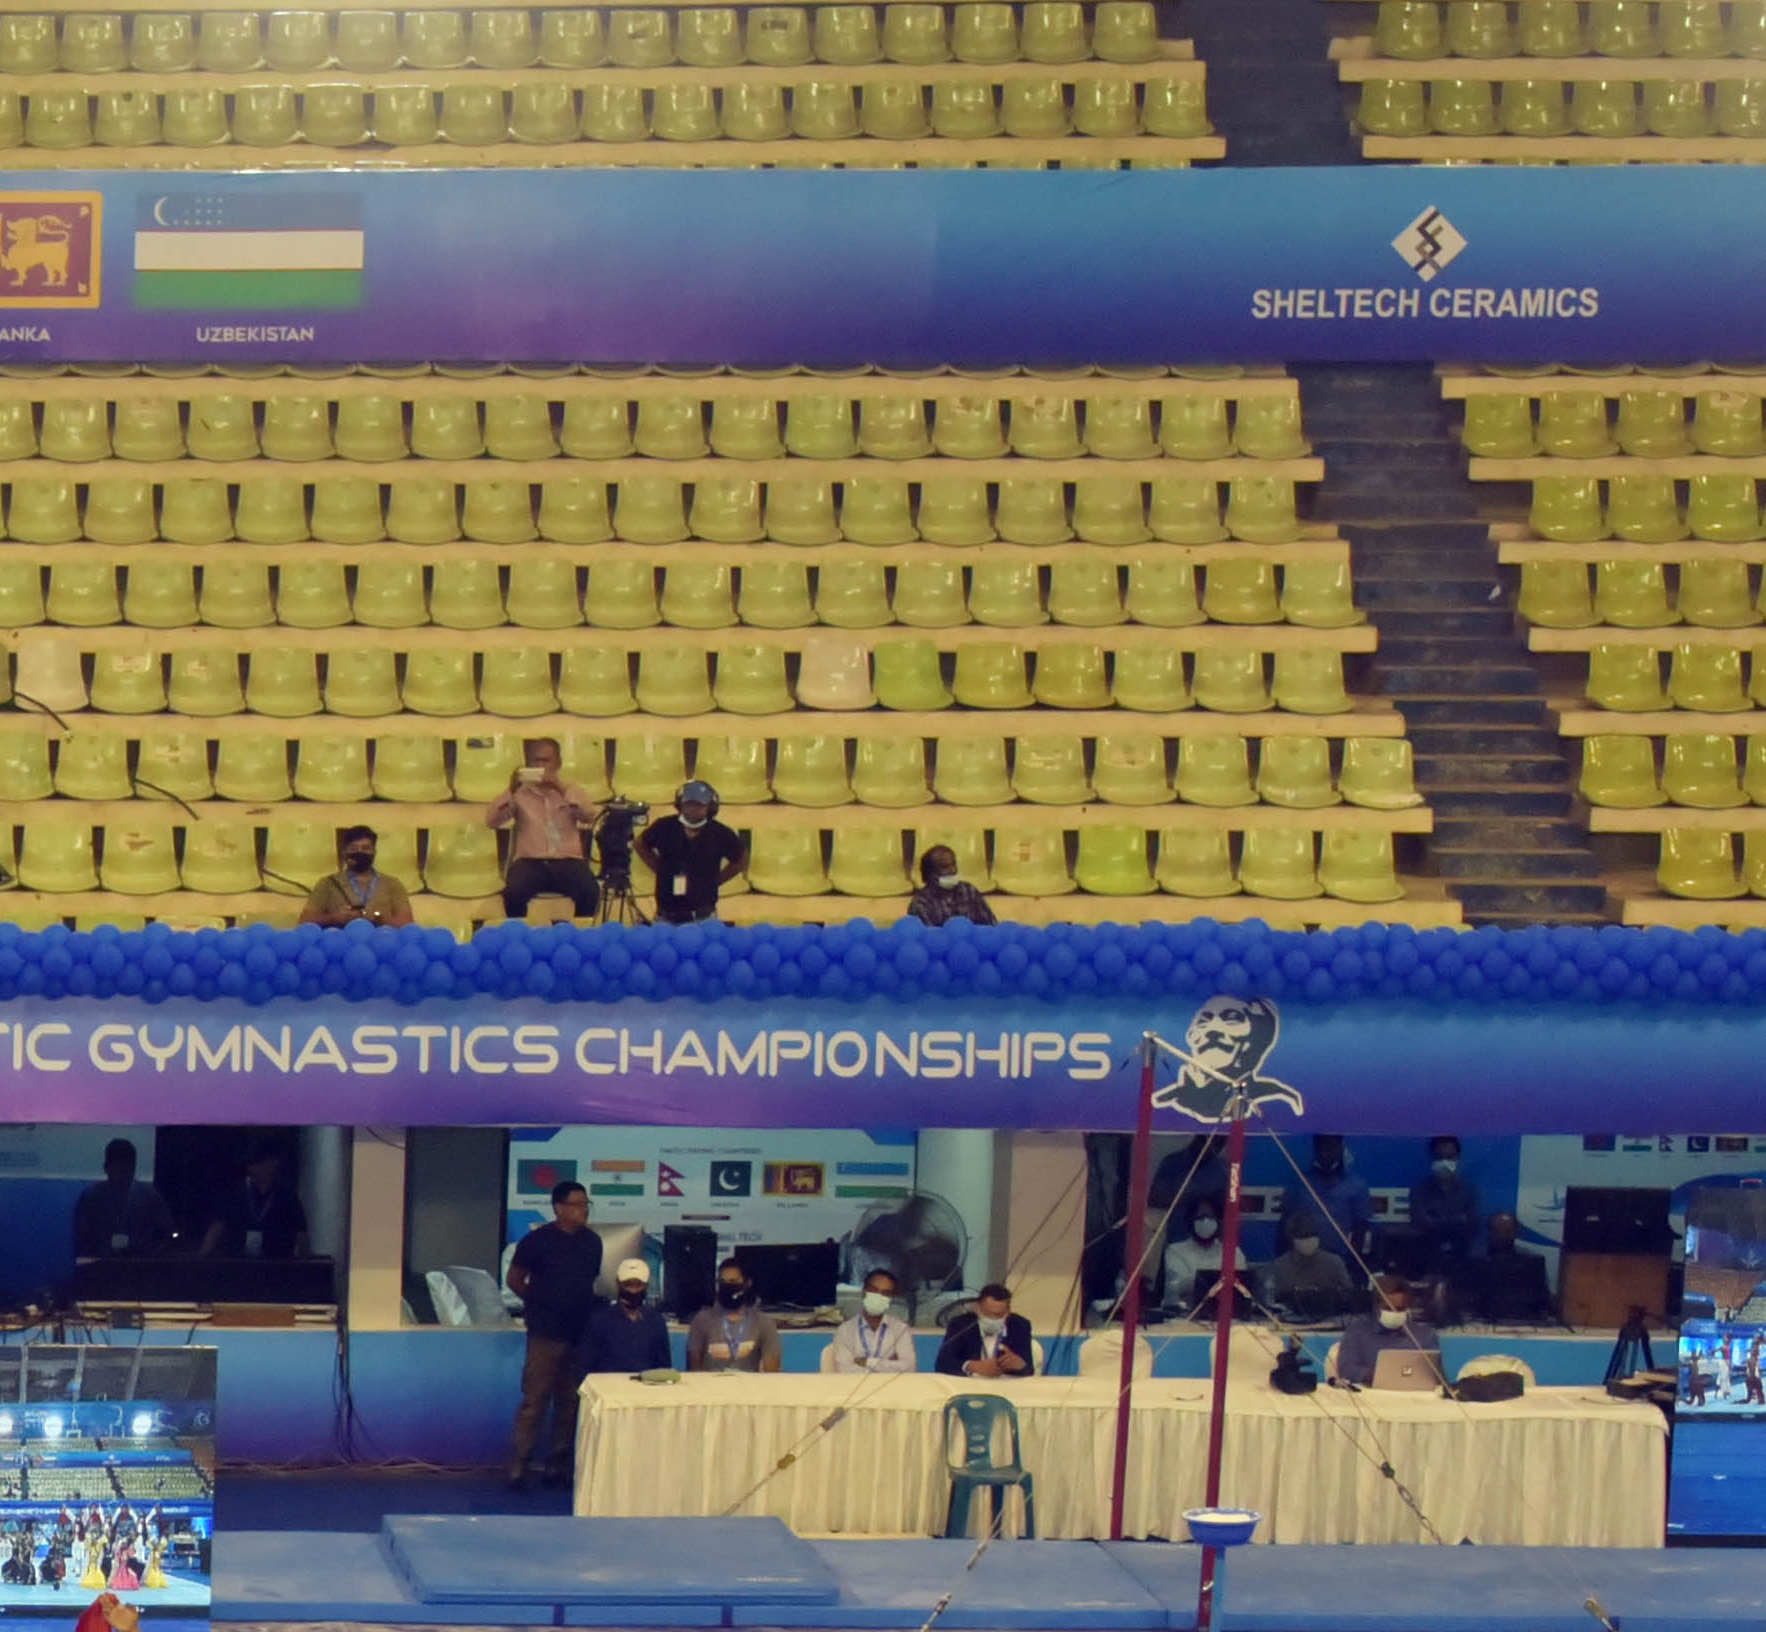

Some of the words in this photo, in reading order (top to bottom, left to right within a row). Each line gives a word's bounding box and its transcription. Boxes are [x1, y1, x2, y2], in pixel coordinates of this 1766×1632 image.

[1251, 288, 1420, 319] SHELTECH
[1429, 287, 1599, 318] CERAMICS
[196, 326, 314, 342] UZBEKISTAN
[88, 1022, 561, 1074] GYMNASTICS
[574, 1026, 1112, 1080] CHAMPIONSHIPS
